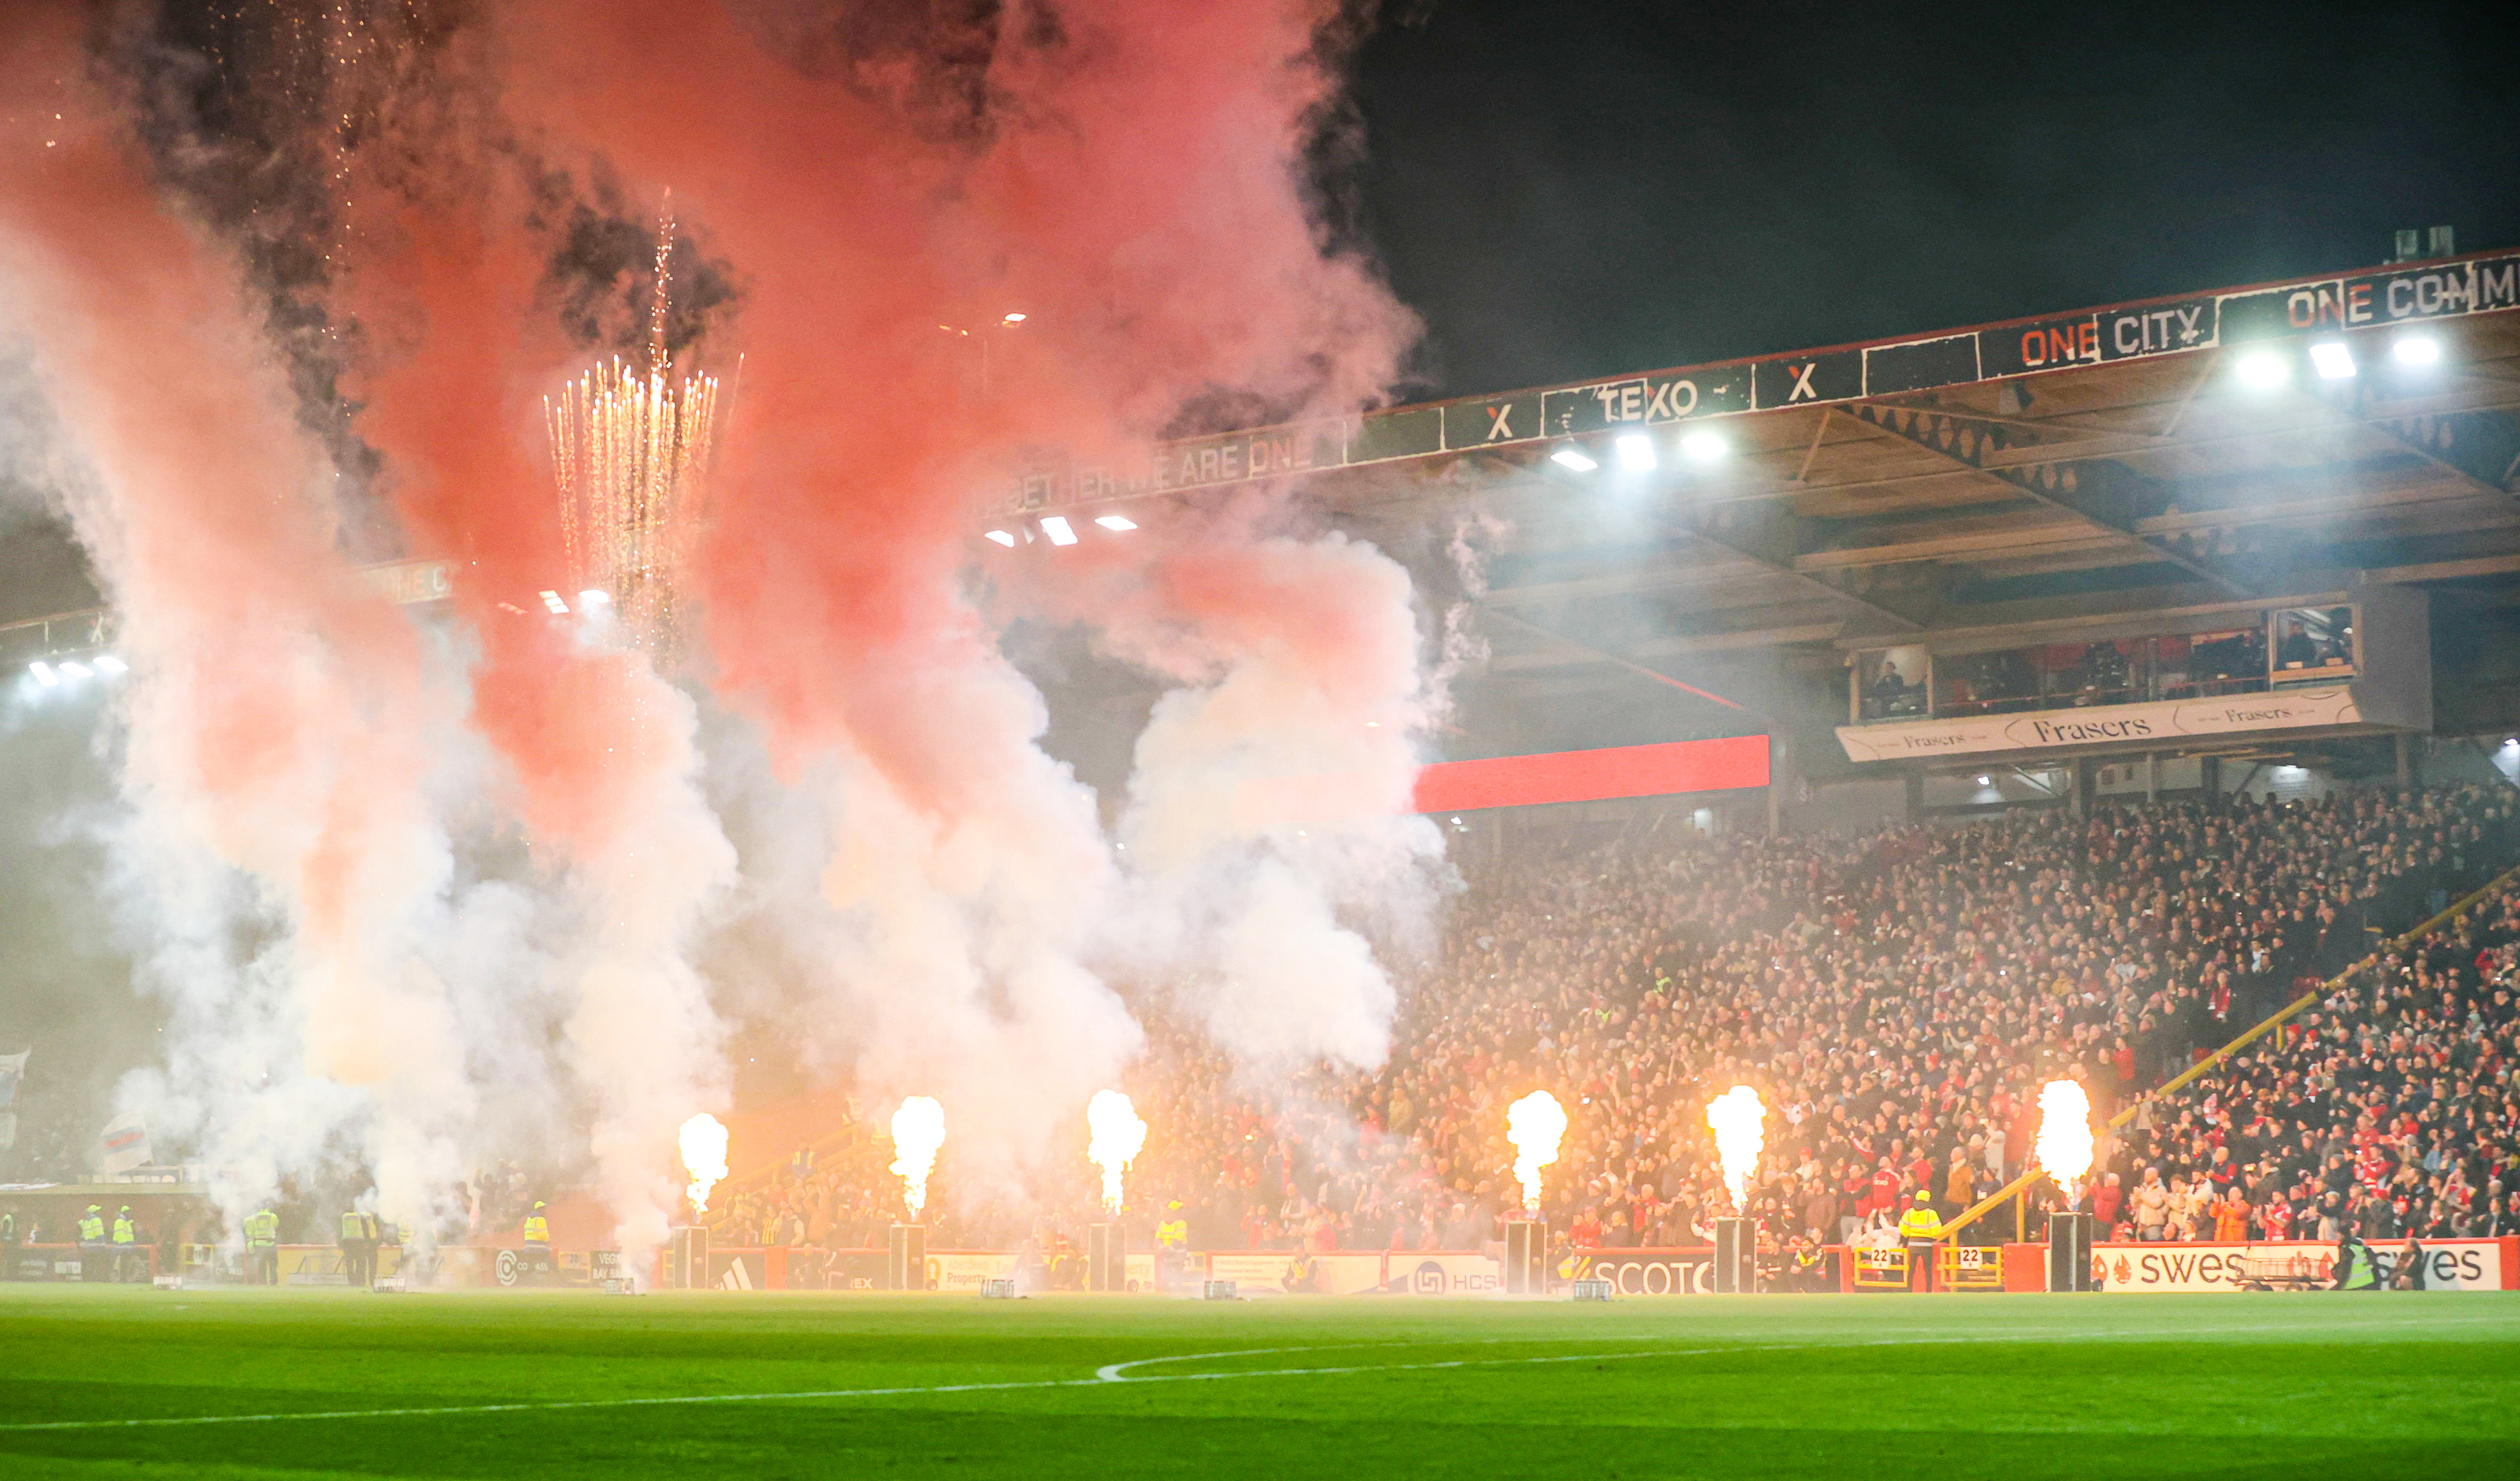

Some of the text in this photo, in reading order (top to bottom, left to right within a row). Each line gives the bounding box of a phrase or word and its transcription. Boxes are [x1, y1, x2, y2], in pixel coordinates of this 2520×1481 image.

[2021, 263, 2520, 366] ONE CITY ONE COMM
[1788, 363, 1816, 401] X
[1599, 380, 1698, 422] TEXO
[1488, 404, 1512, 440] X
[1180, 445, 1239, 485] ARE
[2032, 713, 2153, 744] Frasers
[2225, 707, 2293, 723] Frasers
[1903, 734, 1967, 749] Frasers
[1873, 1249, 1887, 1262] 22
[1962, 1249, 1978, 1262] 22
[2376, 1249, 2482, 1281] ses
[593, 1268, 608, 1279] BAY
[1454, 1274, 1497, 1290] HCS
